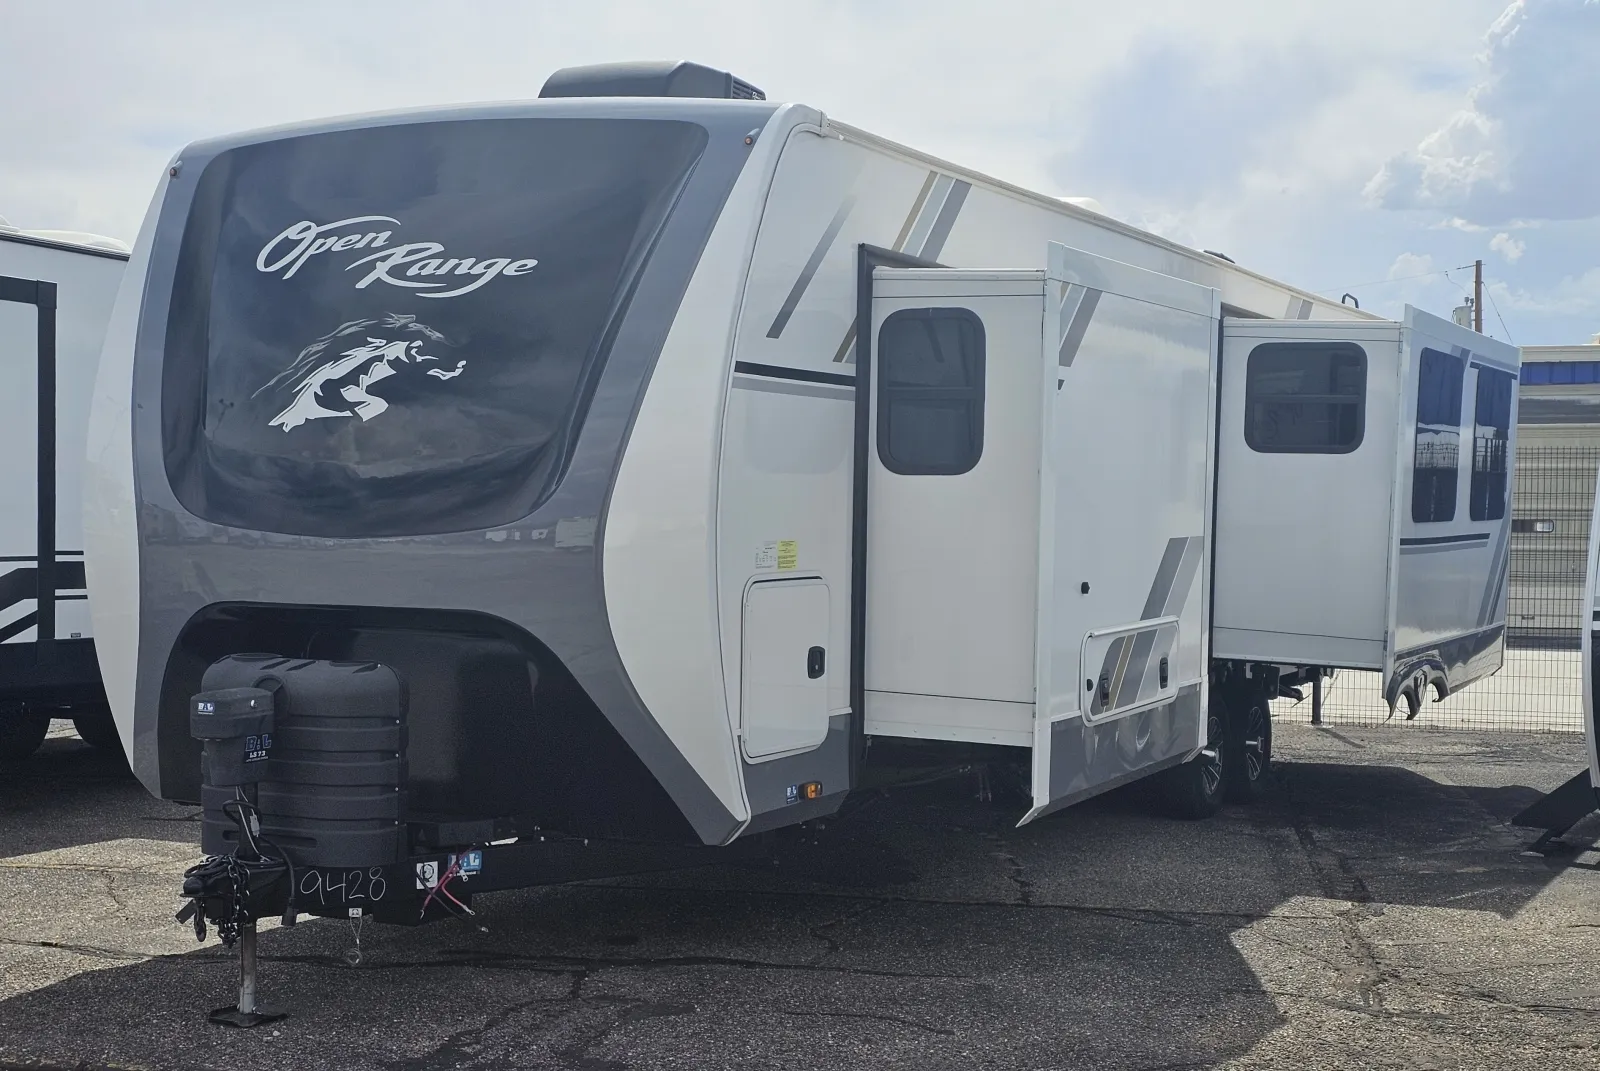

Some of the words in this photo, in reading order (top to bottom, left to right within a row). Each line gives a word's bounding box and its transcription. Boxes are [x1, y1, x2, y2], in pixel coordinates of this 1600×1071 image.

[256, 216, 400, 280] Open
[345, 242, 539, 298] Range
[300, 866, 386, 905] 9428
